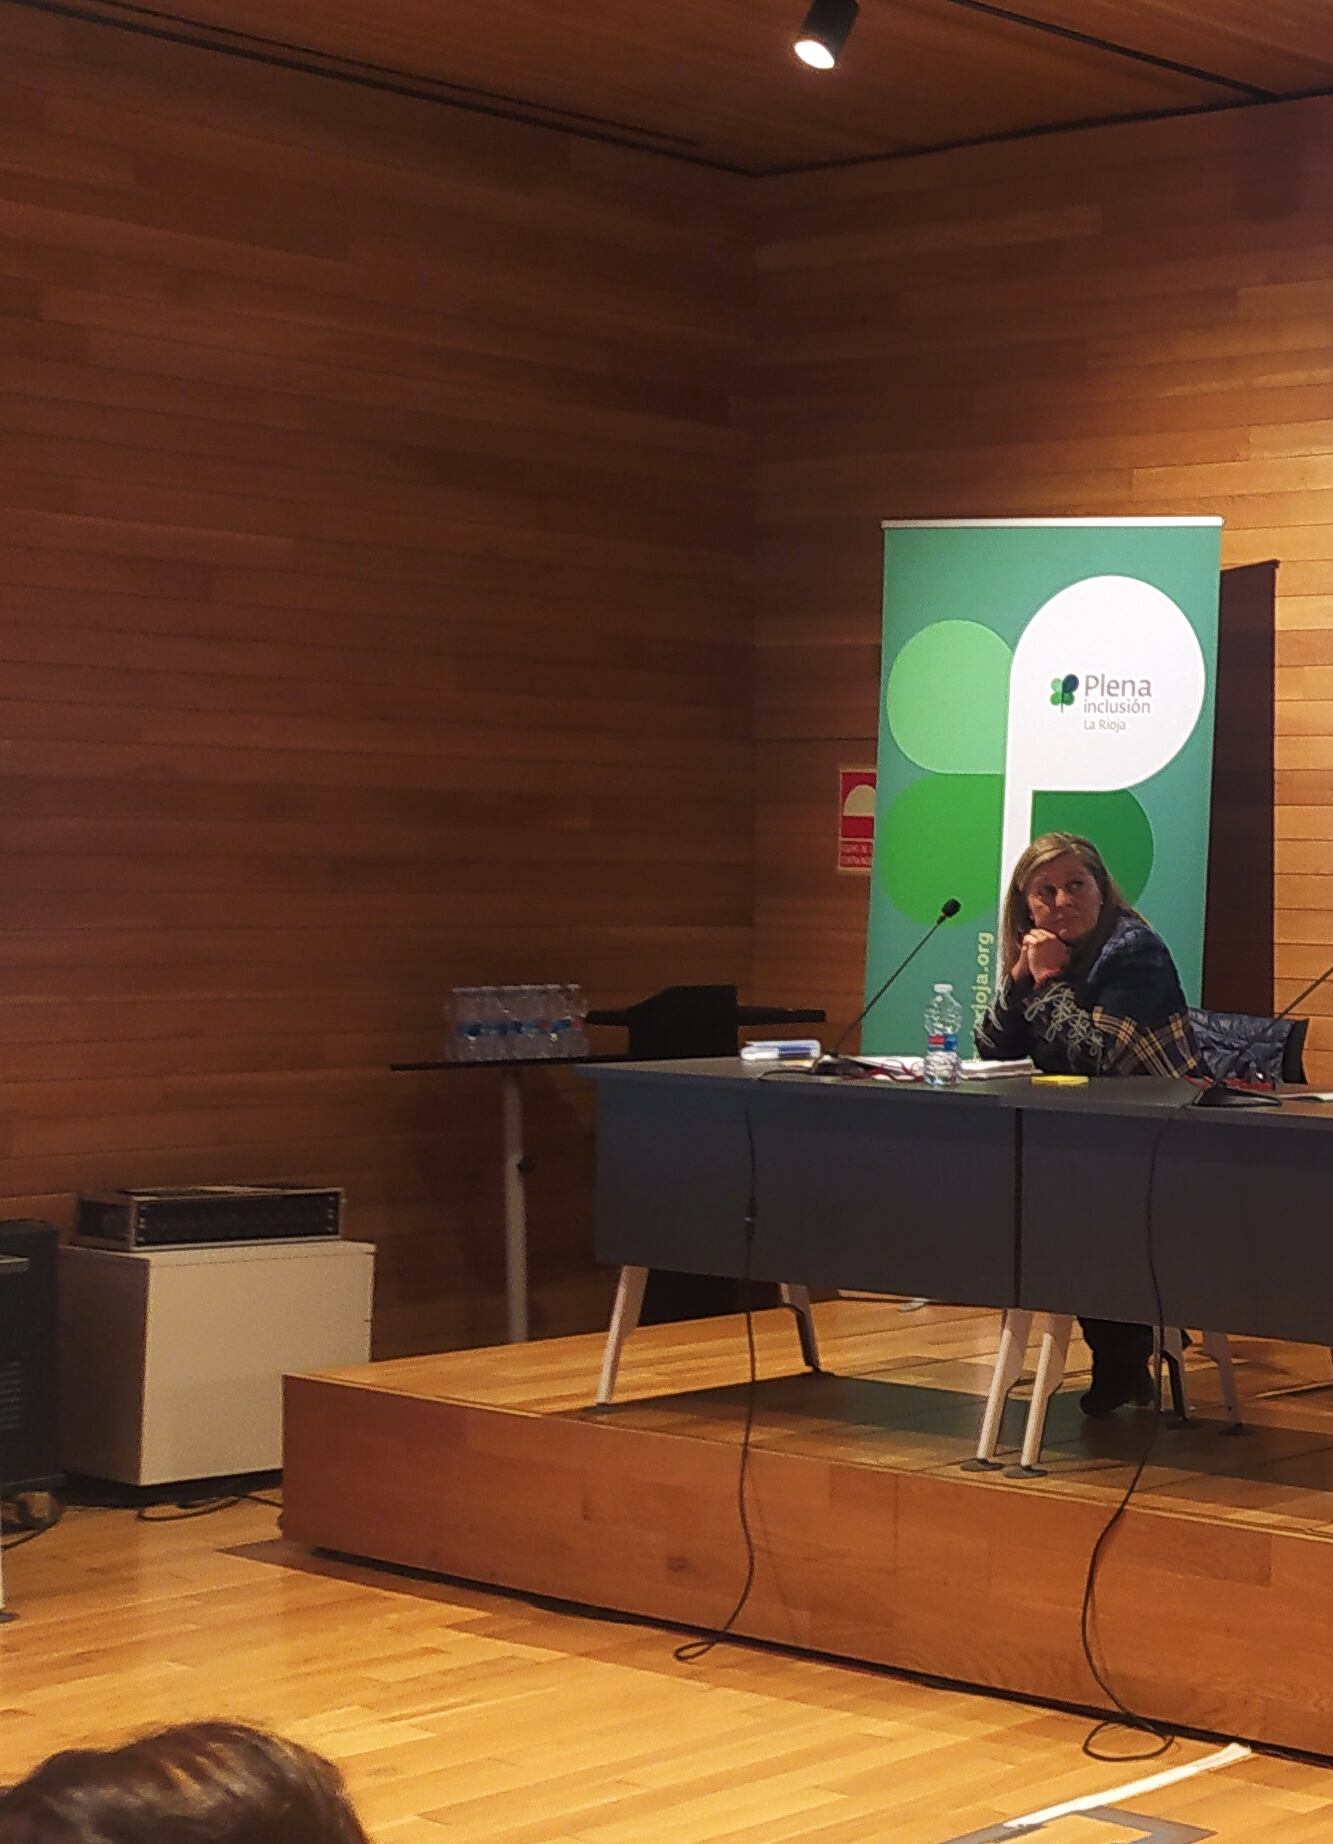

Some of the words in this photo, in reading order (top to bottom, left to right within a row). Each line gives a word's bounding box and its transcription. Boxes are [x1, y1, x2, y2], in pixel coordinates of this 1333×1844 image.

[1084, 673, 1152, 698] Plena
[1083, 698, 1151, 714] inclusión
[1084, 720, 1096, 730] La
[1098, 719, 1127, 734] Rioja
